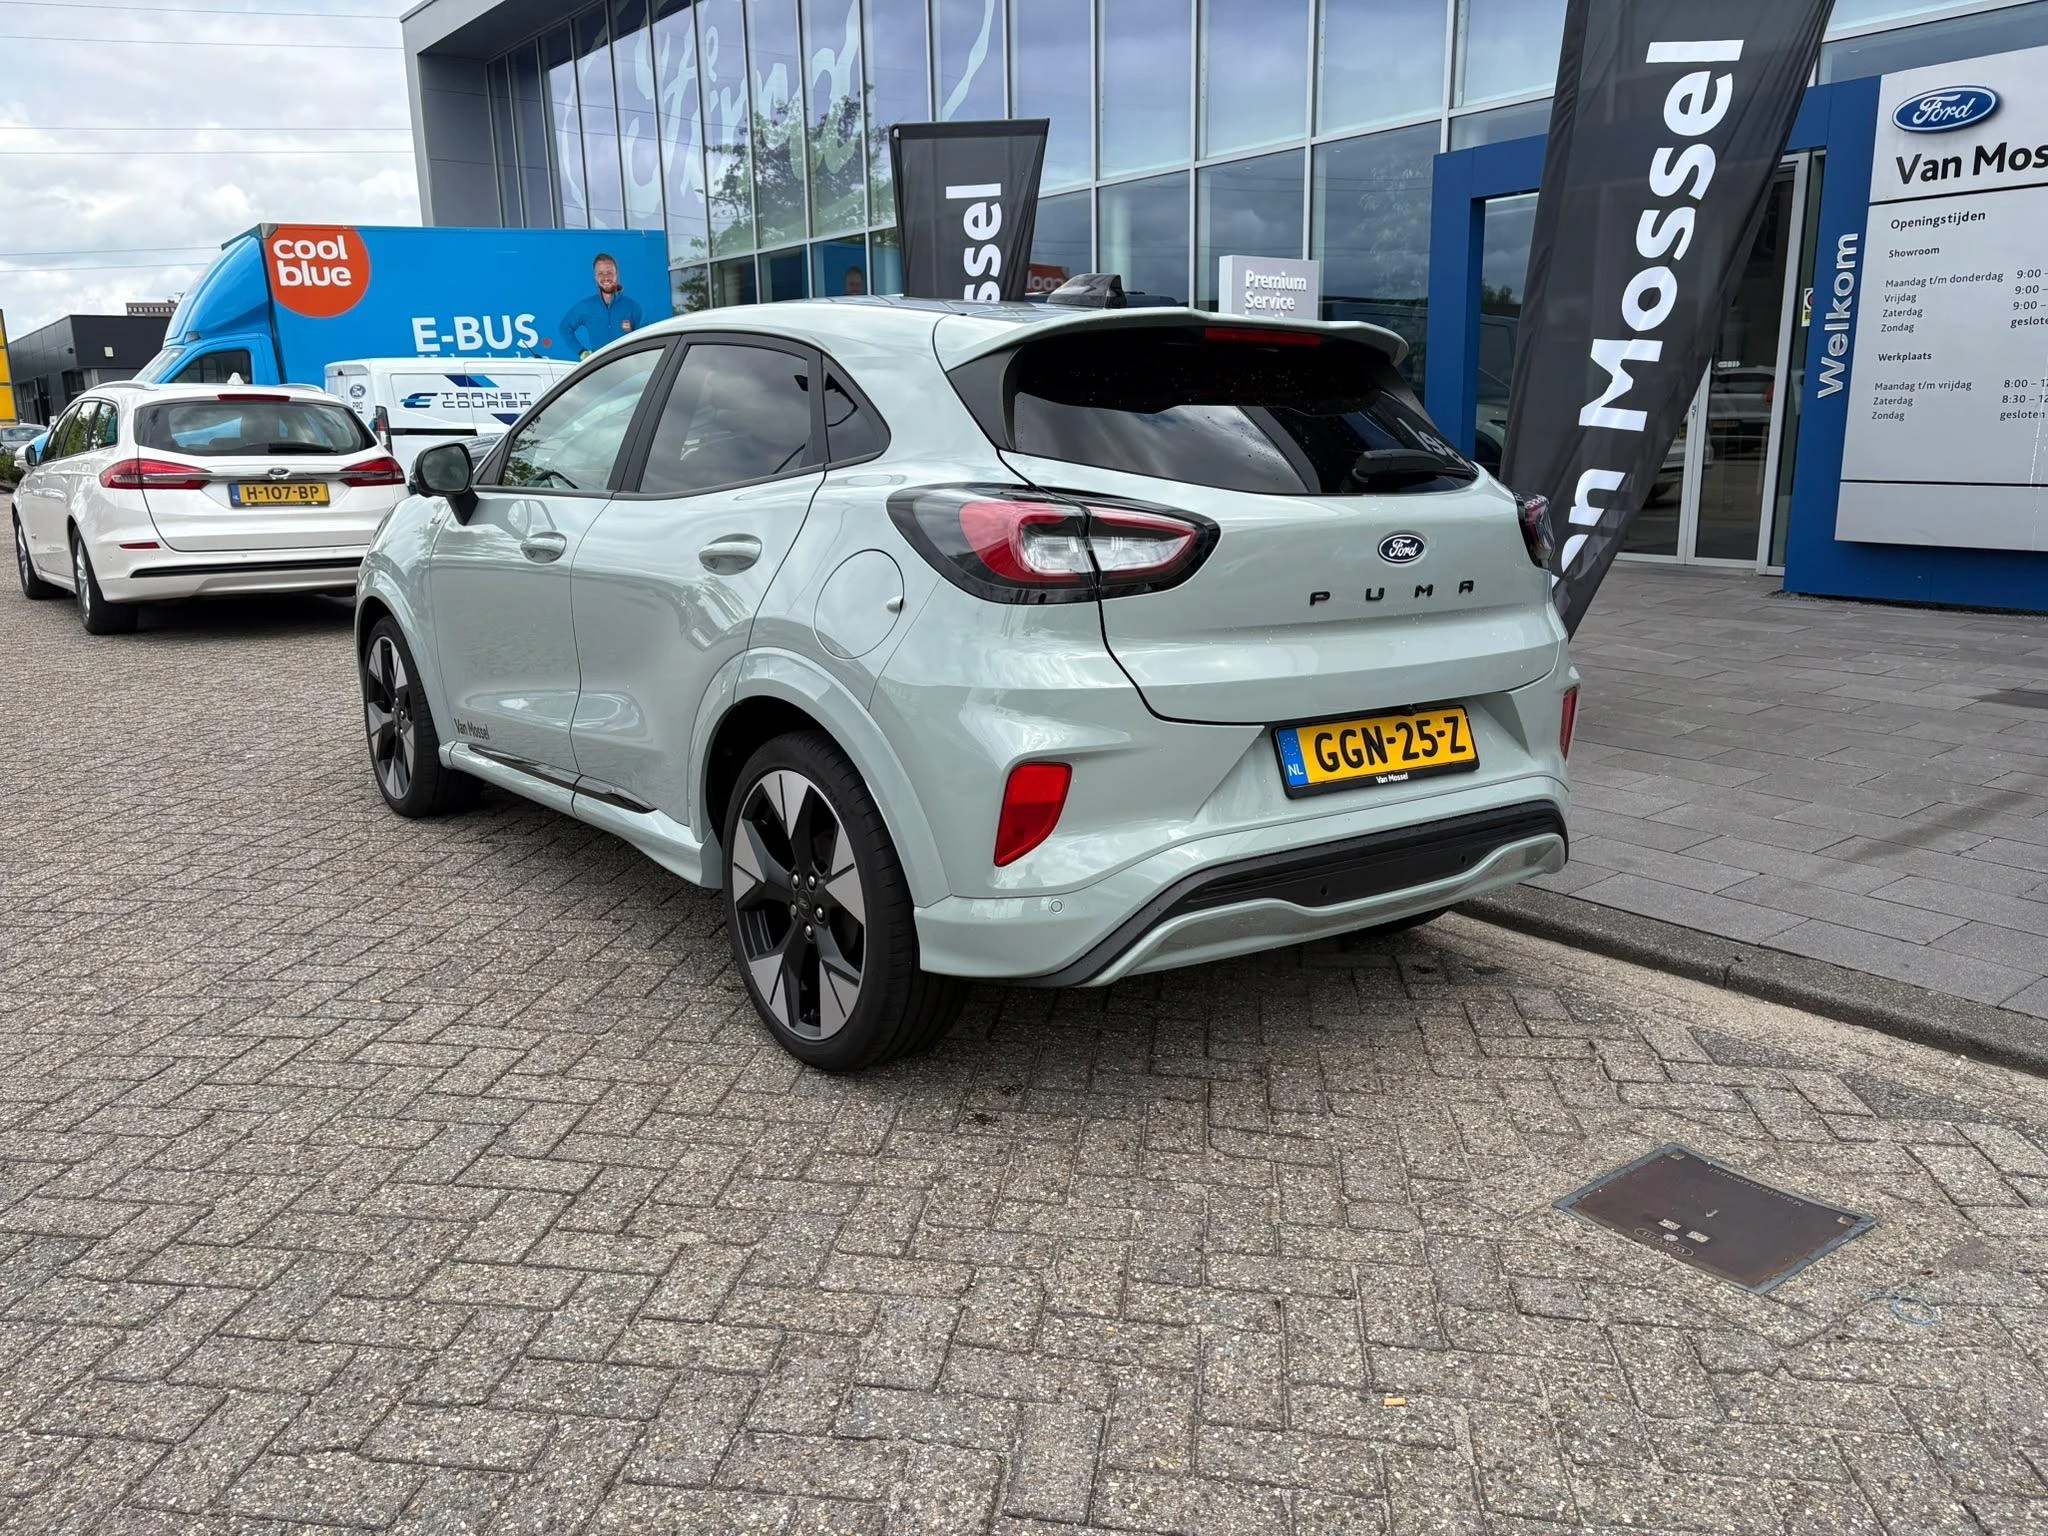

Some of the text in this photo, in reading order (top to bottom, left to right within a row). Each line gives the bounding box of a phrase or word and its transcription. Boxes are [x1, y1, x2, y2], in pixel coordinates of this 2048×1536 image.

[1896, 153, 1962, 185] Van
[1890, 211, 1986, 231] Openingstijden
[1578, 39, 1744, 432] Mossel
[272, 235, 348, 261] cool
[1888, 246, 1940, 259] Showroom
[276, 260, 352, 287] blue
[1245, 269, 1307, 292] Premium
[1885, 277, 1927, 288] Maandag
[1929, 275, 1947, 285] t/m
[1949, 271, 2004, 283] donderdag
[2016, 268, 2042, 279] 9:00
[1245, 291, 1295, 310] Service
[1884, 293, 1917, 304] Vrijdag
[2014, 284, 2040, 295] 9:00
[1817, 233, 1859, 399] Welkom
[1882, 307, 1924, 318] Zaterdag
[2012, 301, 2038, 311] 9:00
[1881, 322, 1915, 333] Zondag
[1878, 352, 1932, 363] Werkplaats
[1874, 381, 1916, 392] Maandag
[1917, 380, 1936, 390] t/m
[1938, 380, 1972, 392] vrijdag
[2003, 378, 2028, 388] 8:00
[440, 392, 531, 400] TRANSIT
[1873, 396, 1913, 407] Zaterdag
[2002, 394, 2026, 404] 8:30
[1871, 409, 2045, 422] Zondag gesloten
[245, 485, 319, 500] H-107-BP
[1309, 580, 1474, 606] PUMA
[453, 717, 490, 740] Van Mossel
[1313, 715, 1467, 773] GGN-25-Z
[1287, 763, 1304, 777] NL
[1375, 771, 1409, 784] Van Mossel
